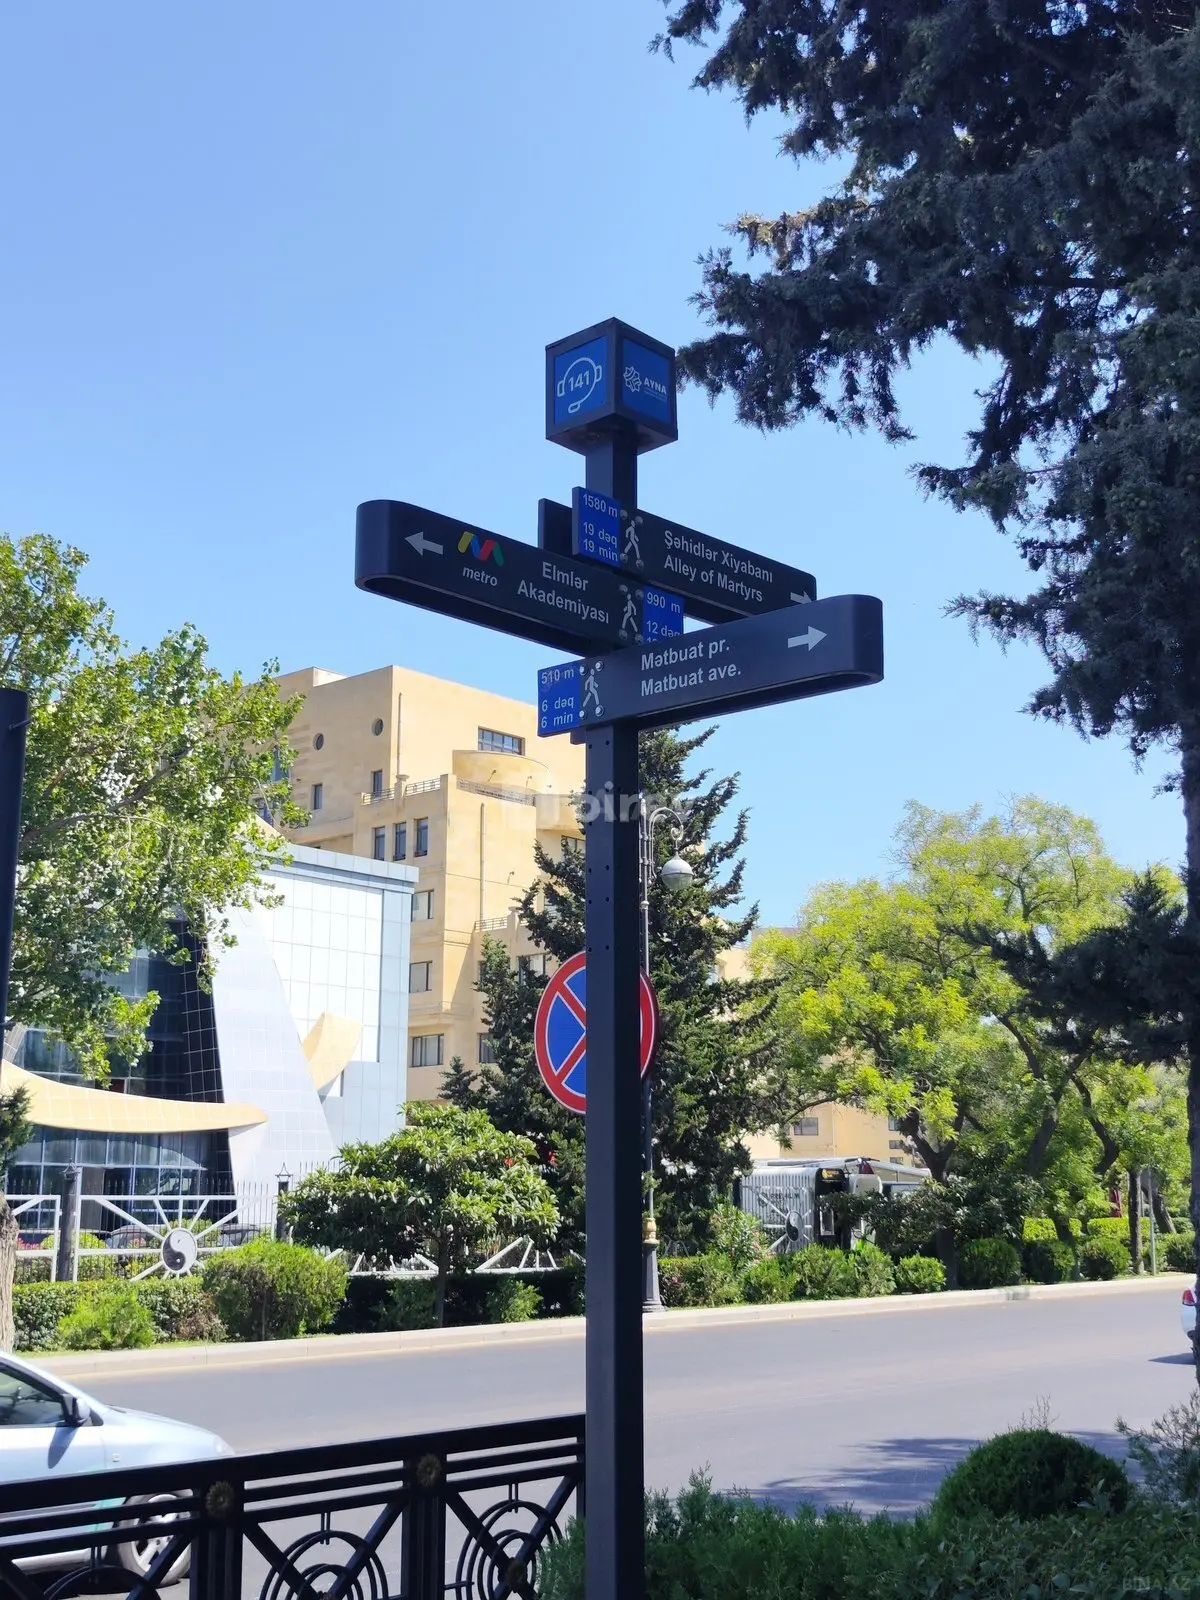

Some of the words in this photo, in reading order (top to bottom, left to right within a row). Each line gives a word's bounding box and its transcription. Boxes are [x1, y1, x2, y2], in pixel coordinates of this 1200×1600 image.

[568, 370, 590, 392] 141
[644, 376, 667, 395] AYNA
[583, 493, 606, 513] 1580
[608, 505, 618, 518] m
[583, 521, 595, 536] 19
[598, 528, 618, 549] dəq
[583, 538, 595, 553] 19
[598, 546, 618, 561] min
[664, 529, 719, 562] Şəhidlər
[721, 551, 773, 583] Xiyabanı
[462, 566, 498, 588] metro
[542, 560, 589, 592] Elmlər
[664, 554, 697, 583] Alley
[700, 569, 714, 586] of
[717, 573, 763, 602] Martyrs
[517, 580, 609, 624] Akademiyası
[647, 591, 666, 609] 990
[671, 602, 681, 614] m
[646, 620, 659, 635] 12
[641, 643, 704, 671] Mətbuat
[708, 638, 730, 658] pr.
[541, 668, 560, 685] 510
[564, 667, 575, 680] m
[641, 667, 704, 697] Matbuat
[707, 662, 742, 680] ave.
[541, 699, 548, 713] 6
[554, 696, 575, 709] dəq
[541, 716, 548, 729] 6
[553, 711, 574, 726] min
